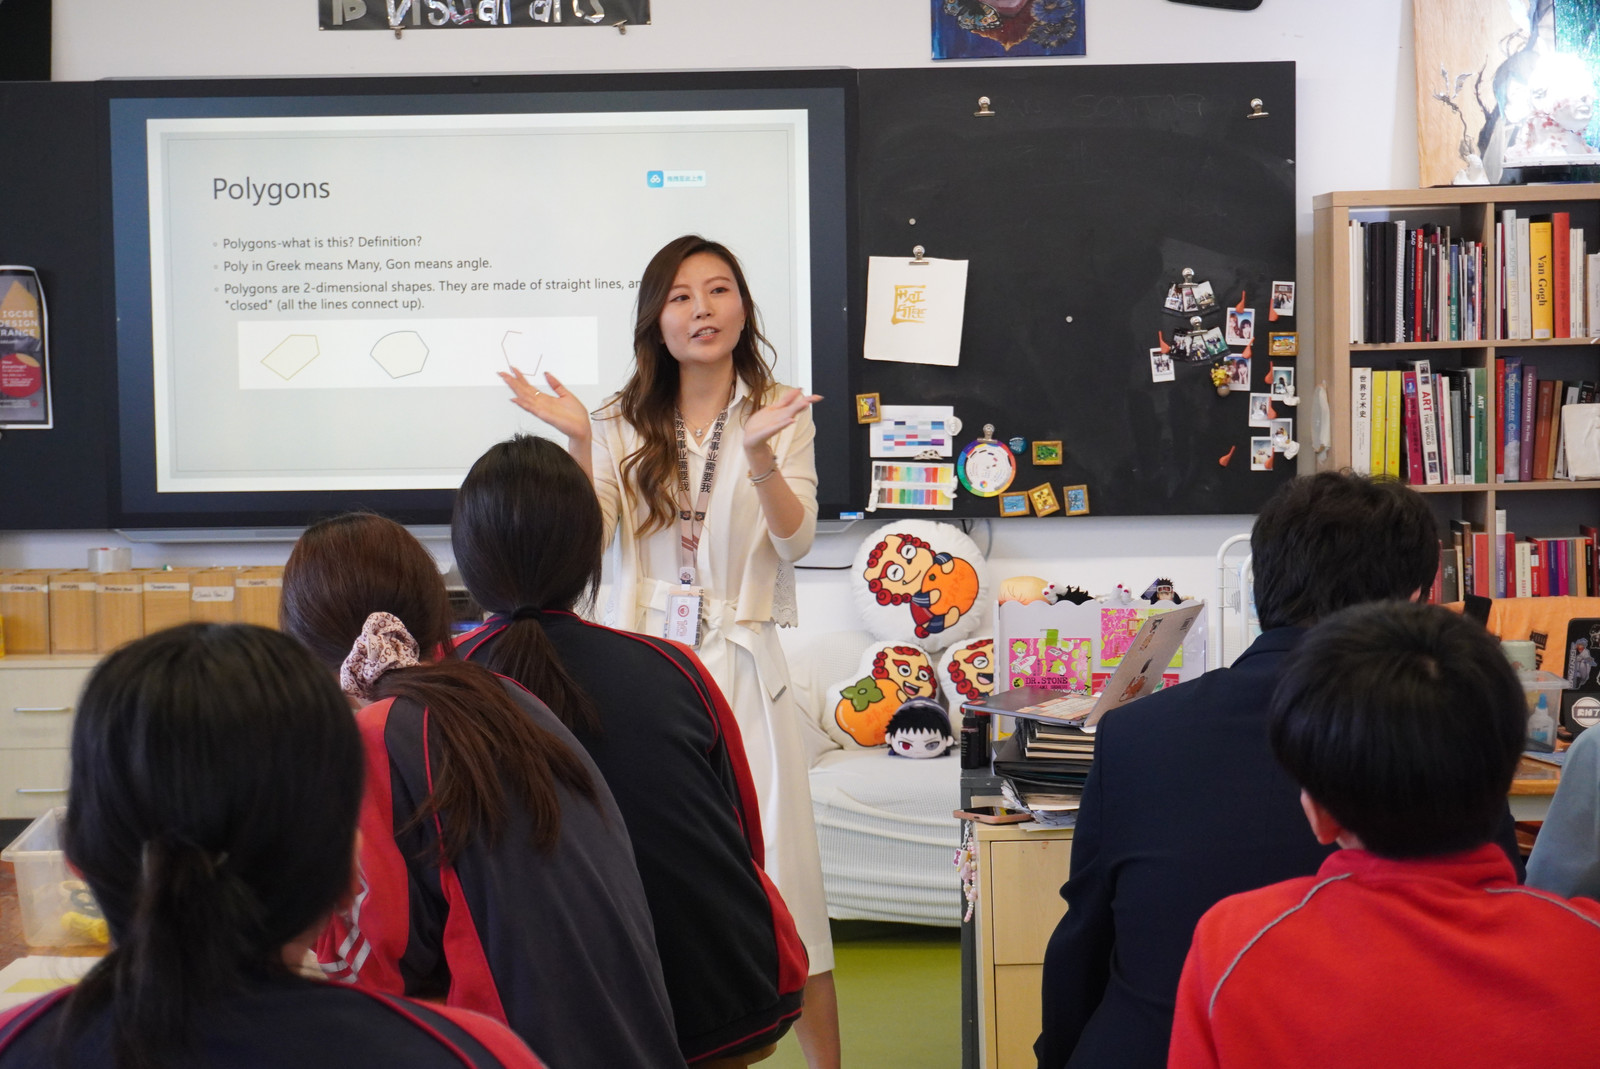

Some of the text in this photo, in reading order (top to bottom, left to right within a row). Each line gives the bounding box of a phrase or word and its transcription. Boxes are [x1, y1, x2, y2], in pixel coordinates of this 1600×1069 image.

[213, 176, 331, 206] Polygons
[222, 235, 423, 252] Polygons-what is this? Definition?
[223, 257, 493, 274] Poly in Greek means Many, Gon means angle.
[224, 278, 642, 297] Polygons are 2-dimensional shapes. They are made of straight lines, an
[1536, 255, 1548, 306] Van Gogh
[2, 310, 34, 318] IGCSE
[277, 298, 295, 312] (all
[298, 298, 317, 310] the
[320, 298, 348, 310] lines
[351, 299, 399, 310] connect
[402, 297, 425, 311] up).
[1359, 374, 1368, 419] 世界艺术史
[1421, 391, 1433, 412] ART
[1477, 394, 1485, 409] ART
[1508, 373, 1517, 421] CONTEMPORARY
[674, 409, 690, 492] 教育事业需要我
[1025, 677, 1069, 685] DR.STONE
